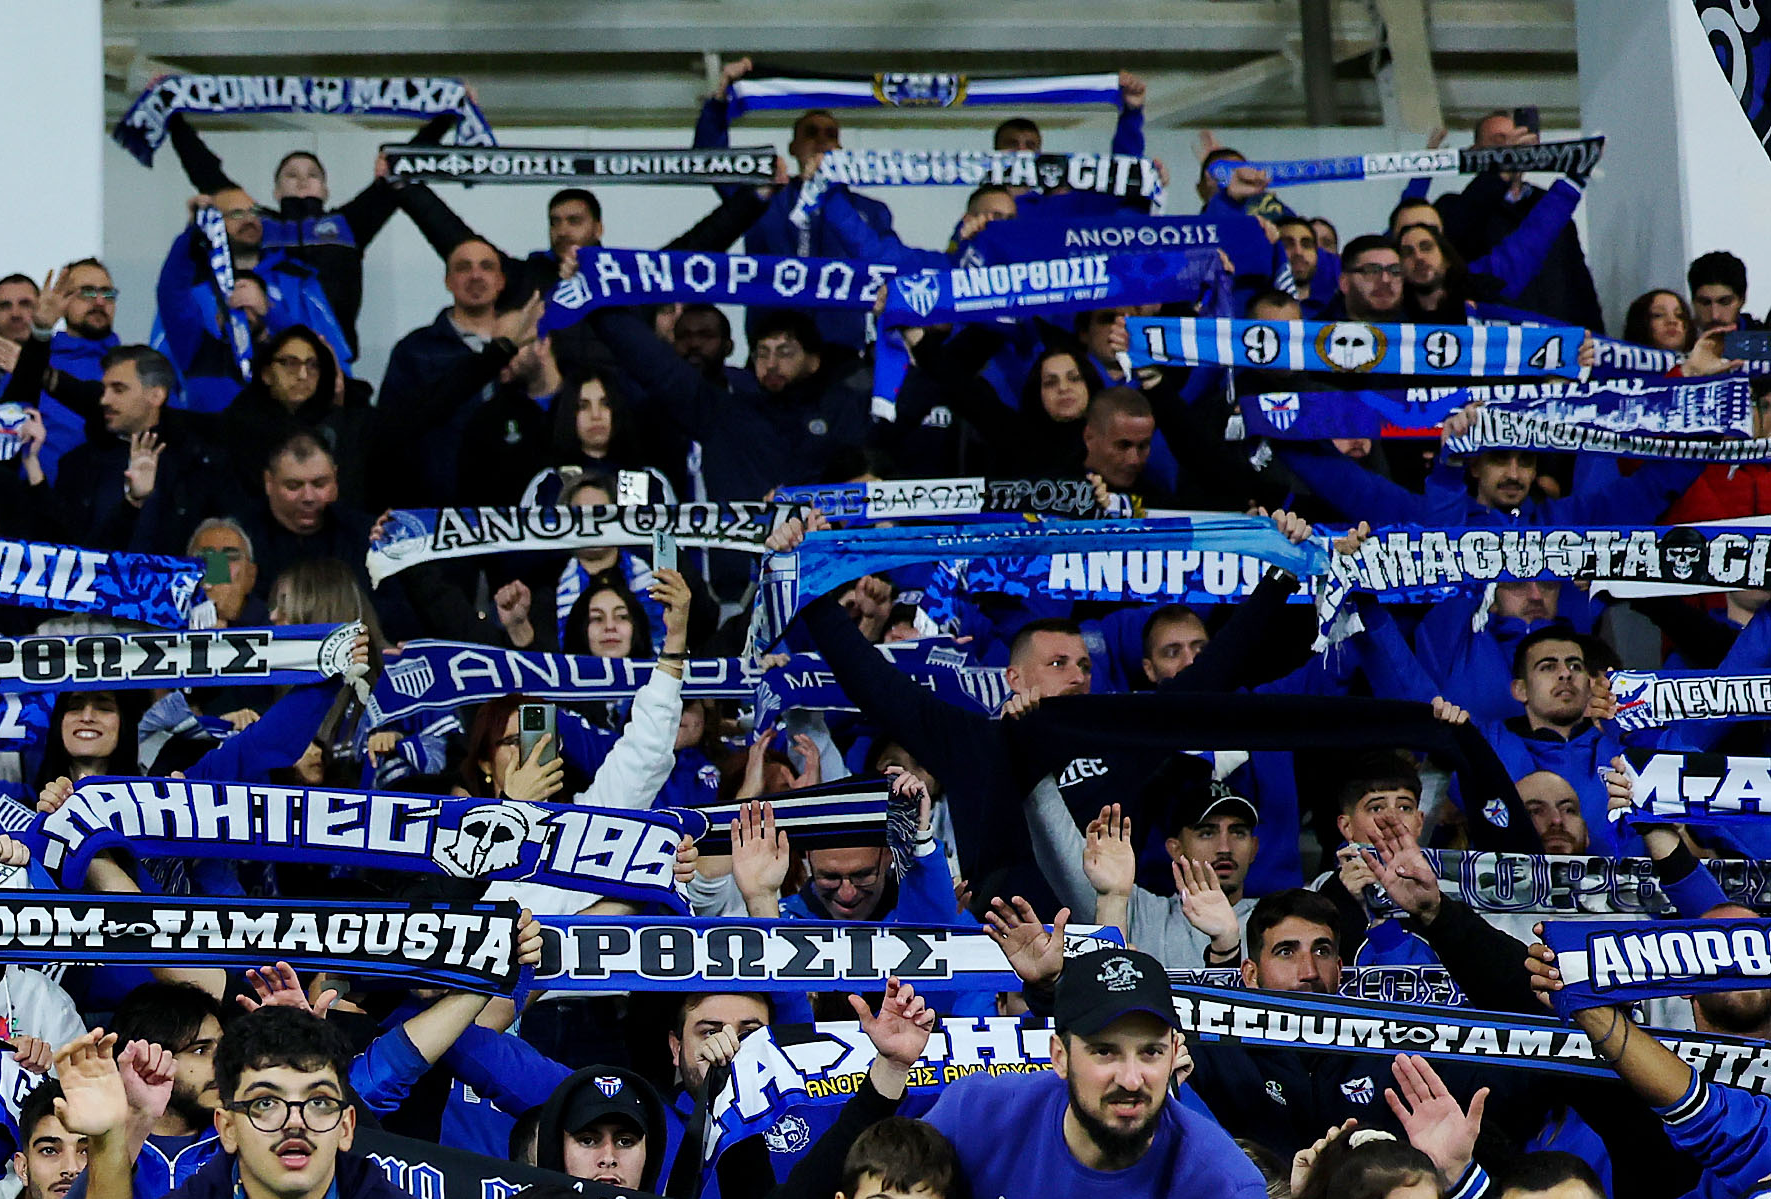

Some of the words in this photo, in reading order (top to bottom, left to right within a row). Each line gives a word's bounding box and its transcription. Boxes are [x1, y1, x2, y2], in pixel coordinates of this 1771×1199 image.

[596, 251, 899, 302] ΑΝΟΡΘΩΣ
[949, 254, 1110, 298] ΑΝΟΡΘΩΣΙΣ
[431, 502, 805, 552] ΑΝΟΡΘΩΣΙ
[150, 907, 515, 977] FAMAGUSTA
[1593, 928, 1771, 988] ΑΝΟΡΘ
[805, 1067, 939, 1098] ΑΝΟΡΣΙΣ
